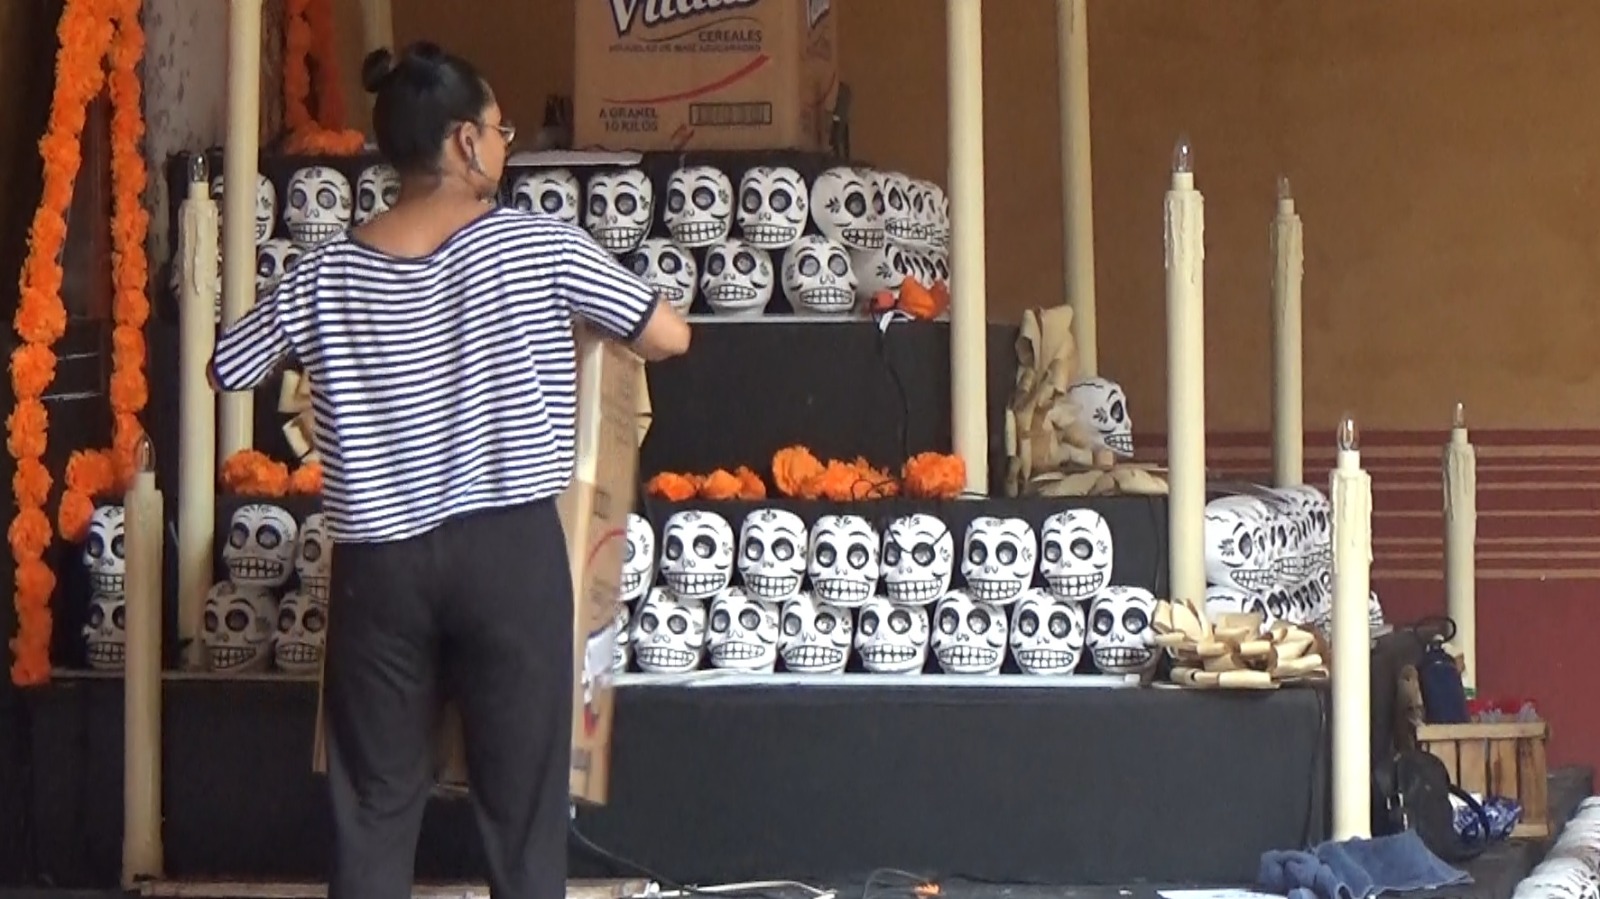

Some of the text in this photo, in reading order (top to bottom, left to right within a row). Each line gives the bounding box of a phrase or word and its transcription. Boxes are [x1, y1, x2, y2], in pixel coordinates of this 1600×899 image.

[698, 30, 763, 42] CEREALES
[599, 106, 659, 119] A GRANEL
[605, 121, 659, 132] 10 KILOS
